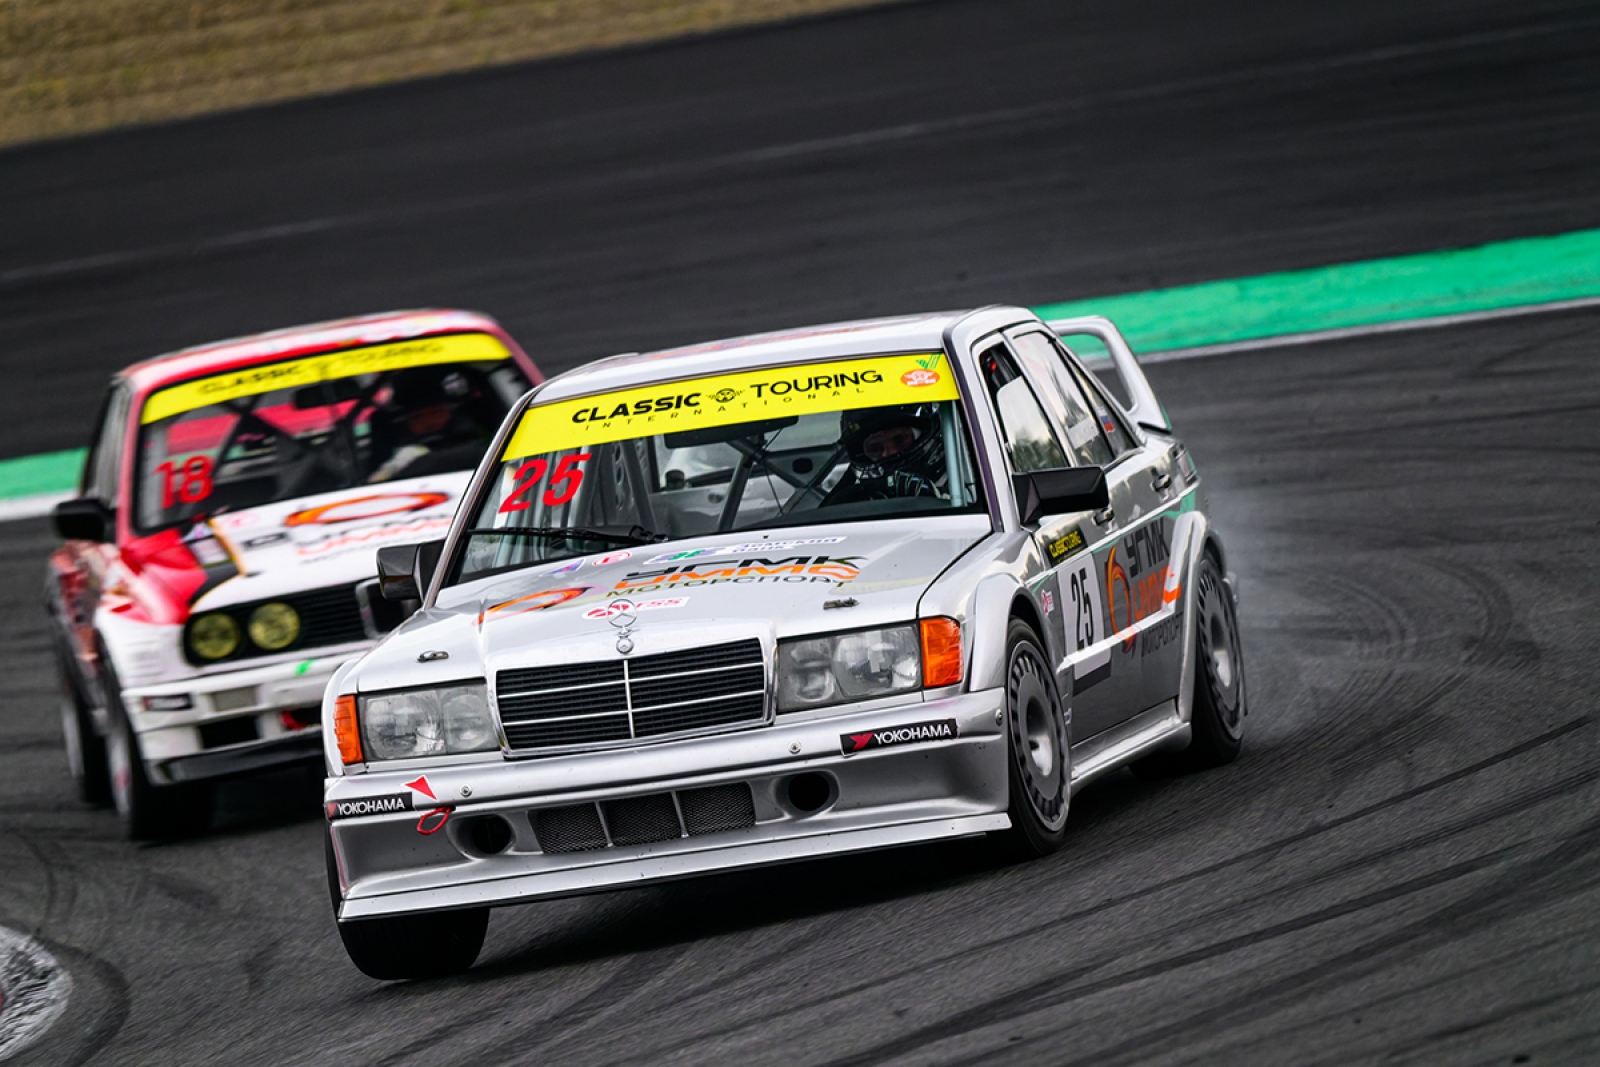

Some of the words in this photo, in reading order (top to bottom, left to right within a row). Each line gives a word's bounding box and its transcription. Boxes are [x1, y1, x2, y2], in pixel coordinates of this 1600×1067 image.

[572, 391, 702, 424] CLASSIC
[750, 369, 884, 399] TOURING
[584, 386, 865, 431] INTERNATIONAL
[153, 455, 214, 510] 18
[498, 453, 592, 514] 25
[1070, 567, 1094, 652] 25
[875, 724, 952, 744] YOKOHAMA
[338, 798, 405, 816] YOKOHAMA
